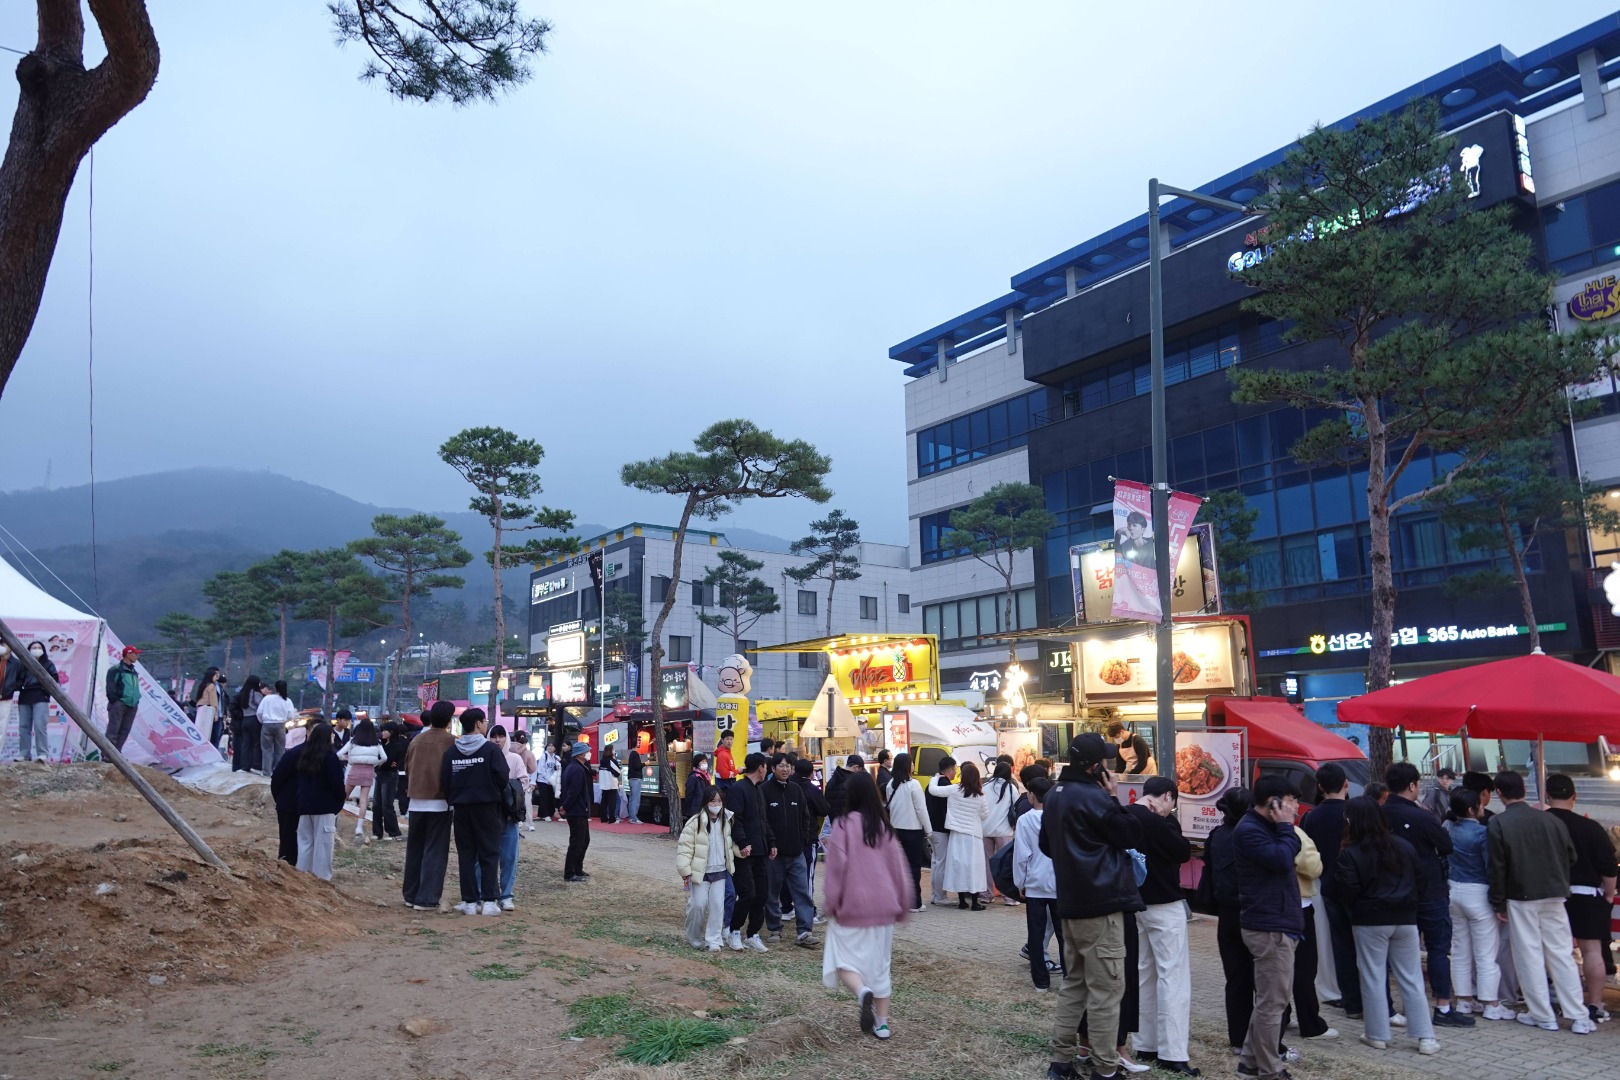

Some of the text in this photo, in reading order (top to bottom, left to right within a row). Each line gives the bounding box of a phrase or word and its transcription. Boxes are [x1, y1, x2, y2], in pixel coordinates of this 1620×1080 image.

[1585, 274, 1616, 293] HUE
[1573, 290, 1605, 308] Thai
[1427, 625, 1459, 642] 365
[1460, 628, 1487, 640] Auto
[1487, 623, 1518, 638] Bank
[451, 757, 485, 765] UMBRO
[1201, 806, 1216, 816] 양념
